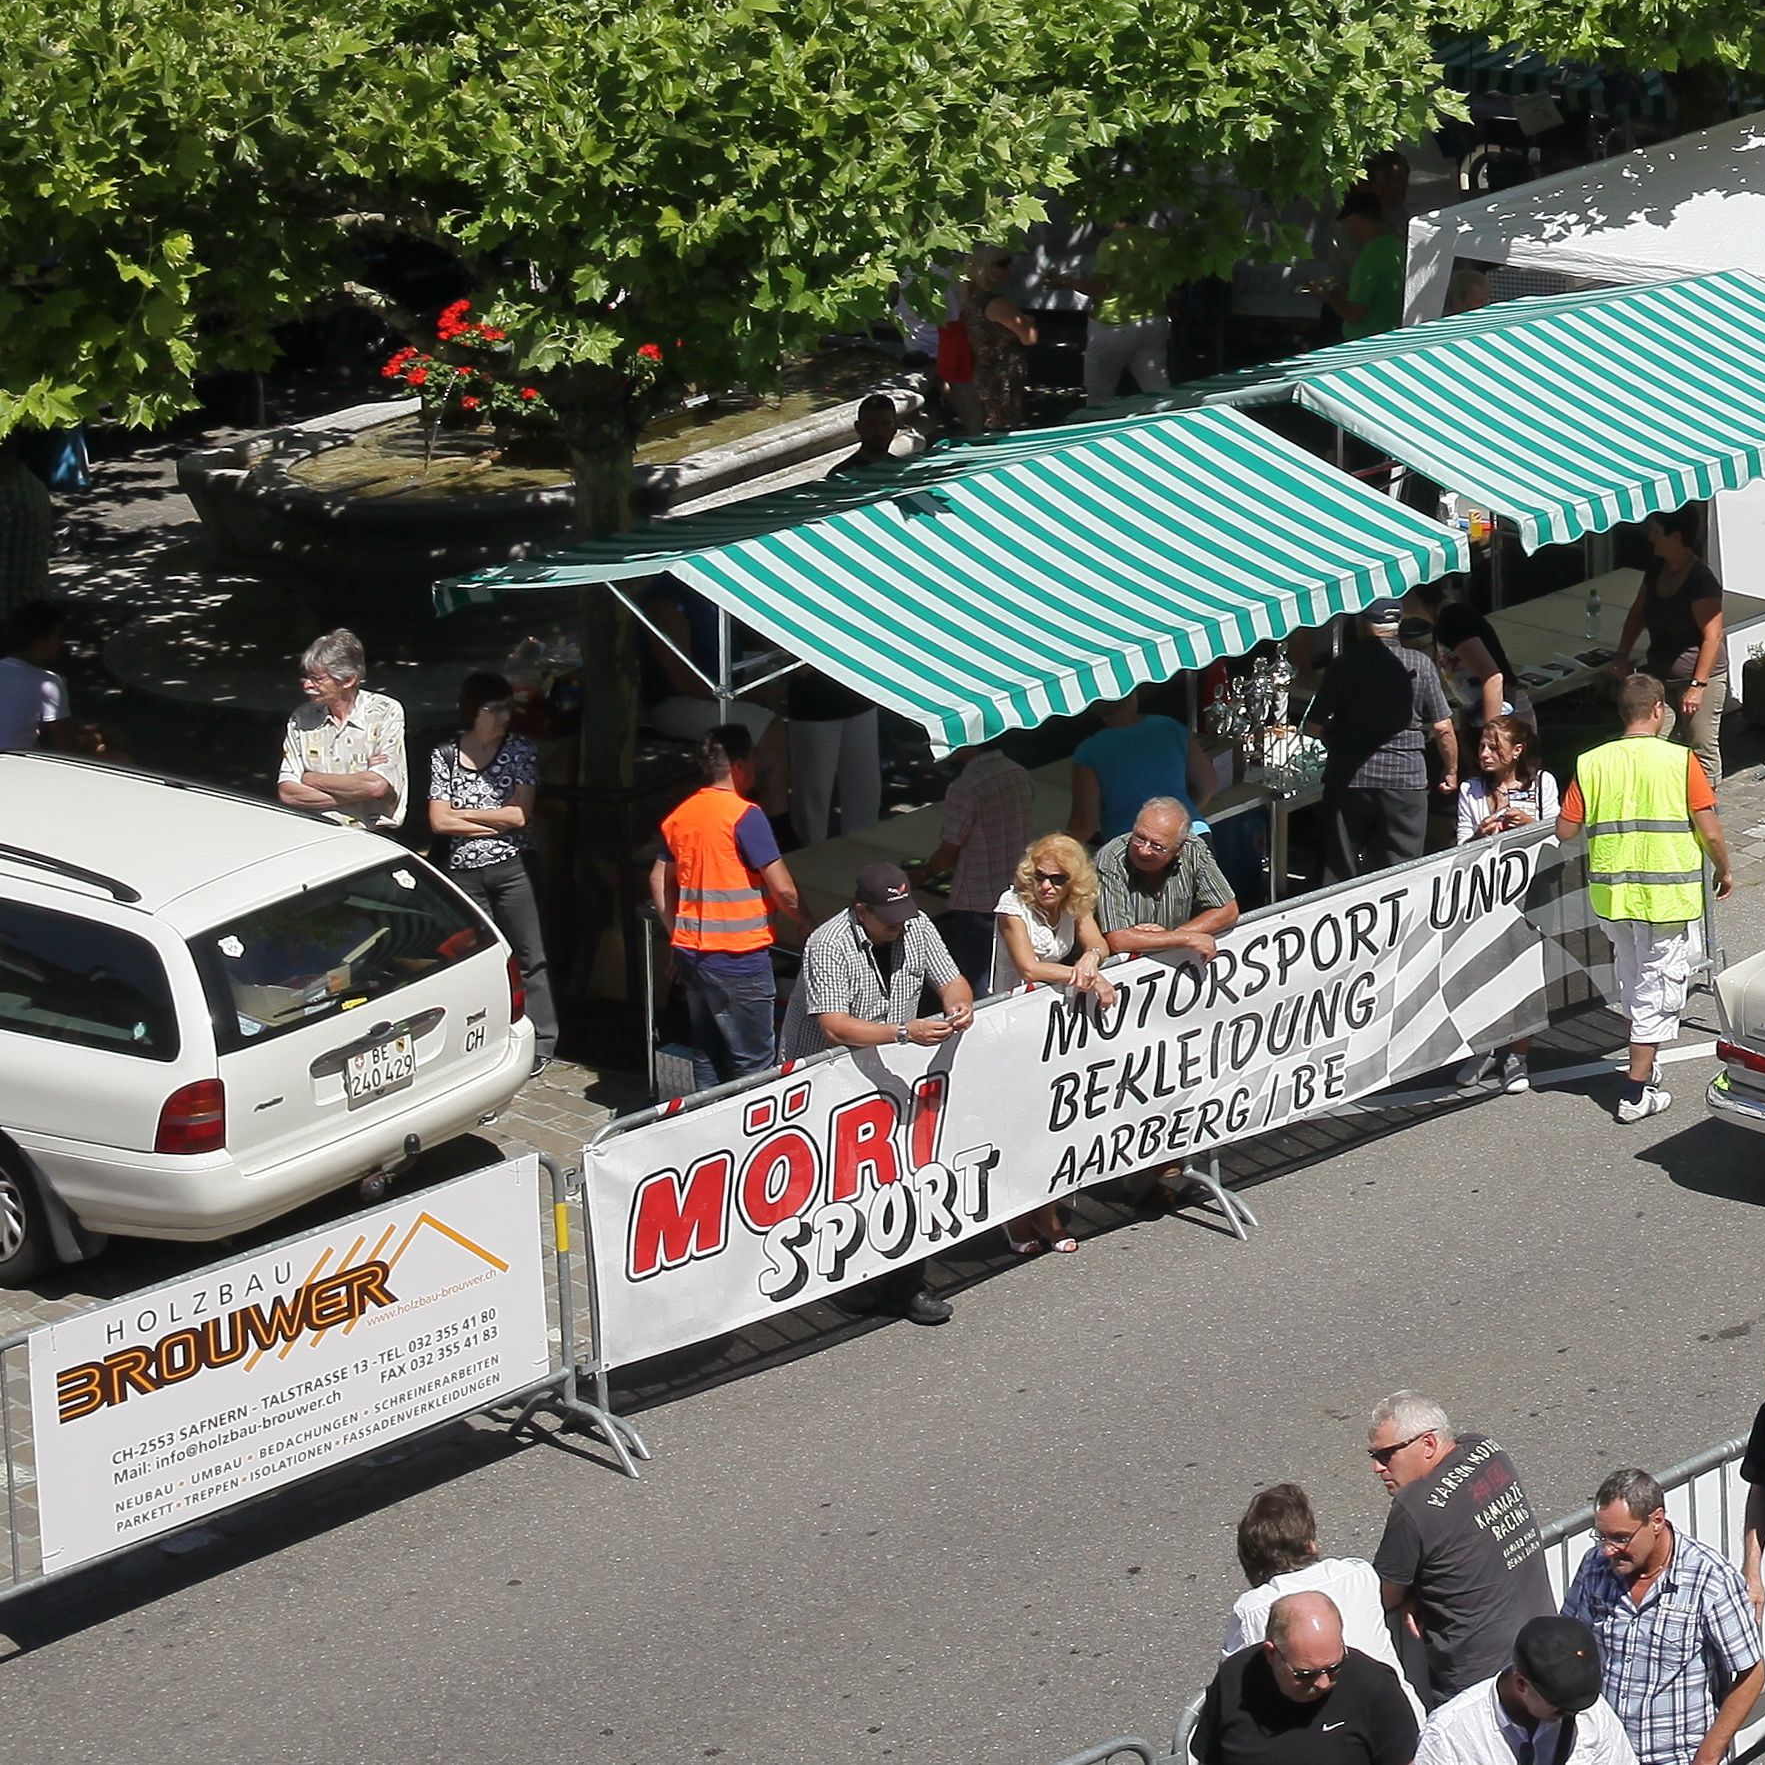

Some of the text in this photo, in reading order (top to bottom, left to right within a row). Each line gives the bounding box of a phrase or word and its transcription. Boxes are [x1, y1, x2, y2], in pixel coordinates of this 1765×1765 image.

[1042, 849, 1531, 1062] MOTORSPORT UND
[372, 1043, 389, 1064] BE
[465, 1026, 486, 1052] CH
[1047, 971, 1377, 1132] BEKLEIDUNG
[626, 1070, 949, 1282] MÖRI
[1047, 1086, 1250, 1193] AARBERG
[1292, 1053, 1347, 1109] BE
[758, 1142, 1001, 1301] SPORT
[57, 1260, 398, 1425] BROUWER
[107, 1262, 291, 1344] HOLZBAU
[366, 1268, 498, 1327] www.holzbau-brouwer.ch
[380, 1326, 498, 1383] FAX 032 355 41 83
[112, 1432, 175, 1465] CH-2553
[179, 1405, 248, 1441] SAFNERN
[261, 1368, 349, 1410] TALSTRASSE
[353, 1359, 368, 1376] 13
[408, 1334, 432, 1354] 032
[435, 1324, 459, 1343] 355
[462, 1317, 477, 1331] 41
[481, 1308, 496, 1322] 80
[113, 1390, 342, 1484] Mail: info@holzbau-brouwer.ch
[115, 1354, 500, 1512] NEUBAU UMBAU BEDACHUNGEN SCHREINERARBEITEN
[116, 1372, 501, 1532] PARKETT TREPPEN ISOLATIONEN FASSADENVERKLEIDUNGEN
[1491, 1503, 1530, 1541] RACING
